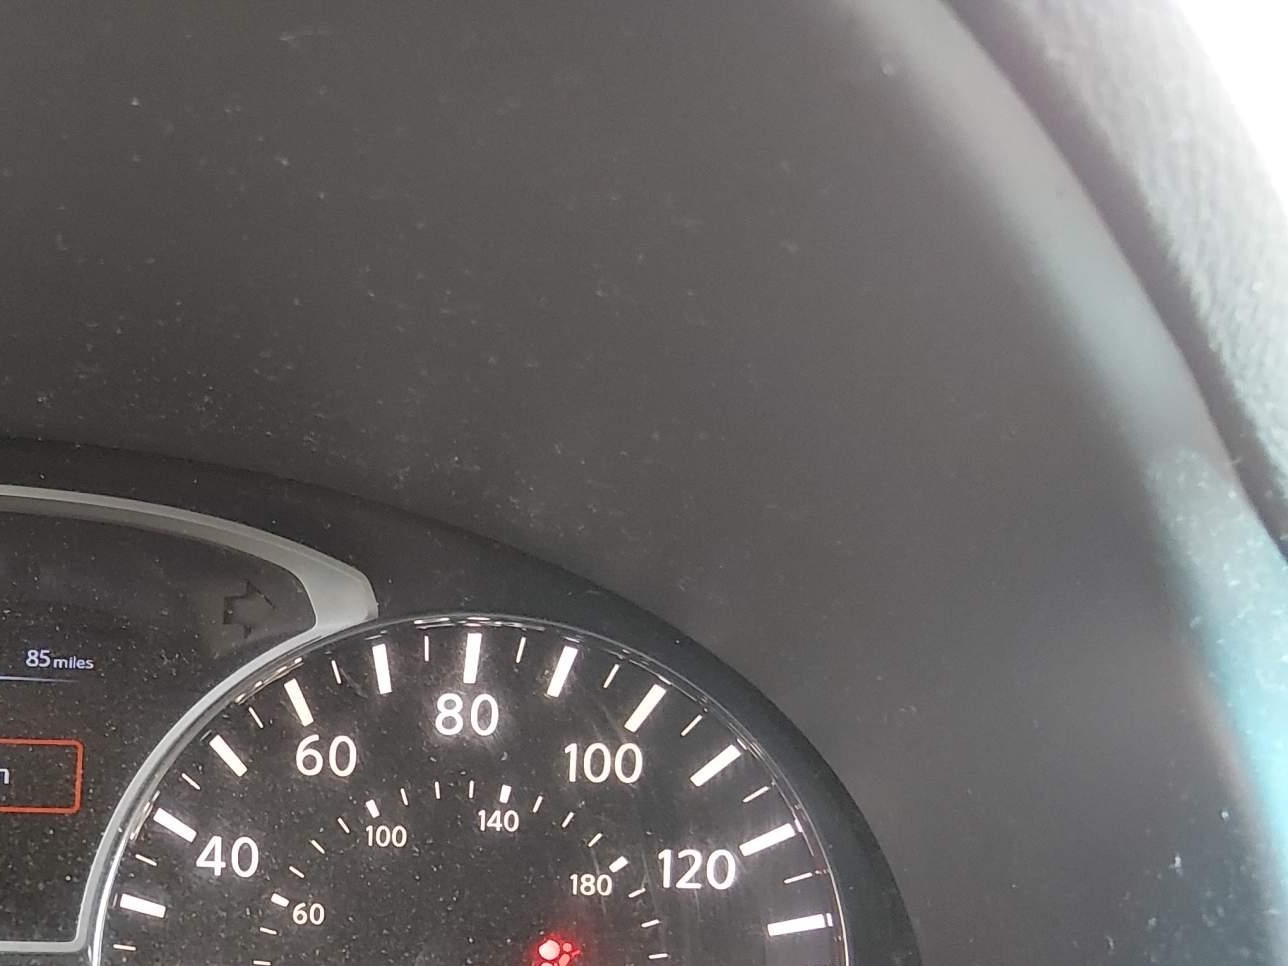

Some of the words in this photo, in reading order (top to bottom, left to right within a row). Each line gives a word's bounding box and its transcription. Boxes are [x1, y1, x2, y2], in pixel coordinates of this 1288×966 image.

[25, 650, 51, 668] 85
[53, 655, 94, 669] miles
[435, 693, 499, 736] 80
[295, 735, 357, 777] 60
[564, 743, 643, 784] 100
[365, 825, 407, 848] 100
[478, 810, 520, 833] 140
[196, 836, 259, 878] 40
[658, 850, 737, 891] 120
[570, 873, 613, 896] 180
[292, 903, 325, 925] 60
